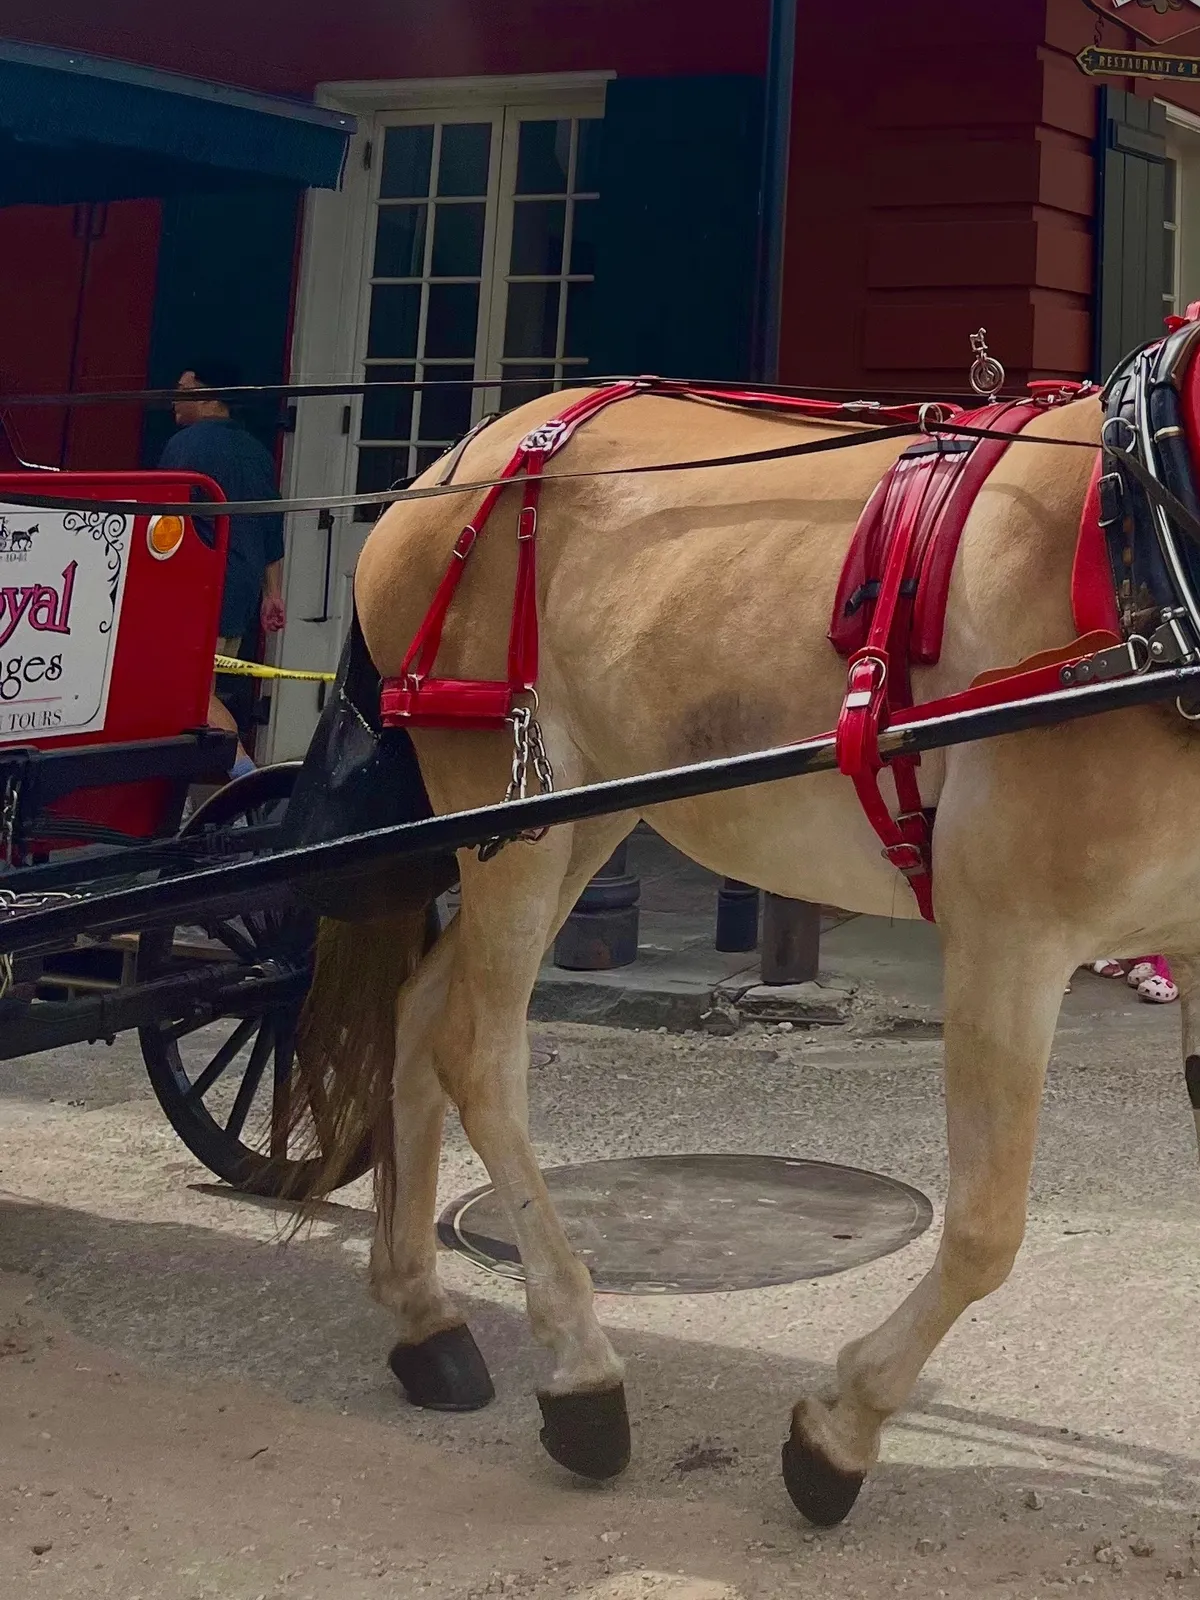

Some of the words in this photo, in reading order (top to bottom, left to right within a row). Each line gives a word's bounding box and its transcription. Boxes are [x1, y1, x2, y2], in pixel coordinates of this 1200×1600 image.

[1098, 54, 1172, 74] RESTAURANT
[1178, 62, 1186, 73] &
[9, 709, 63, 731] TOURS
